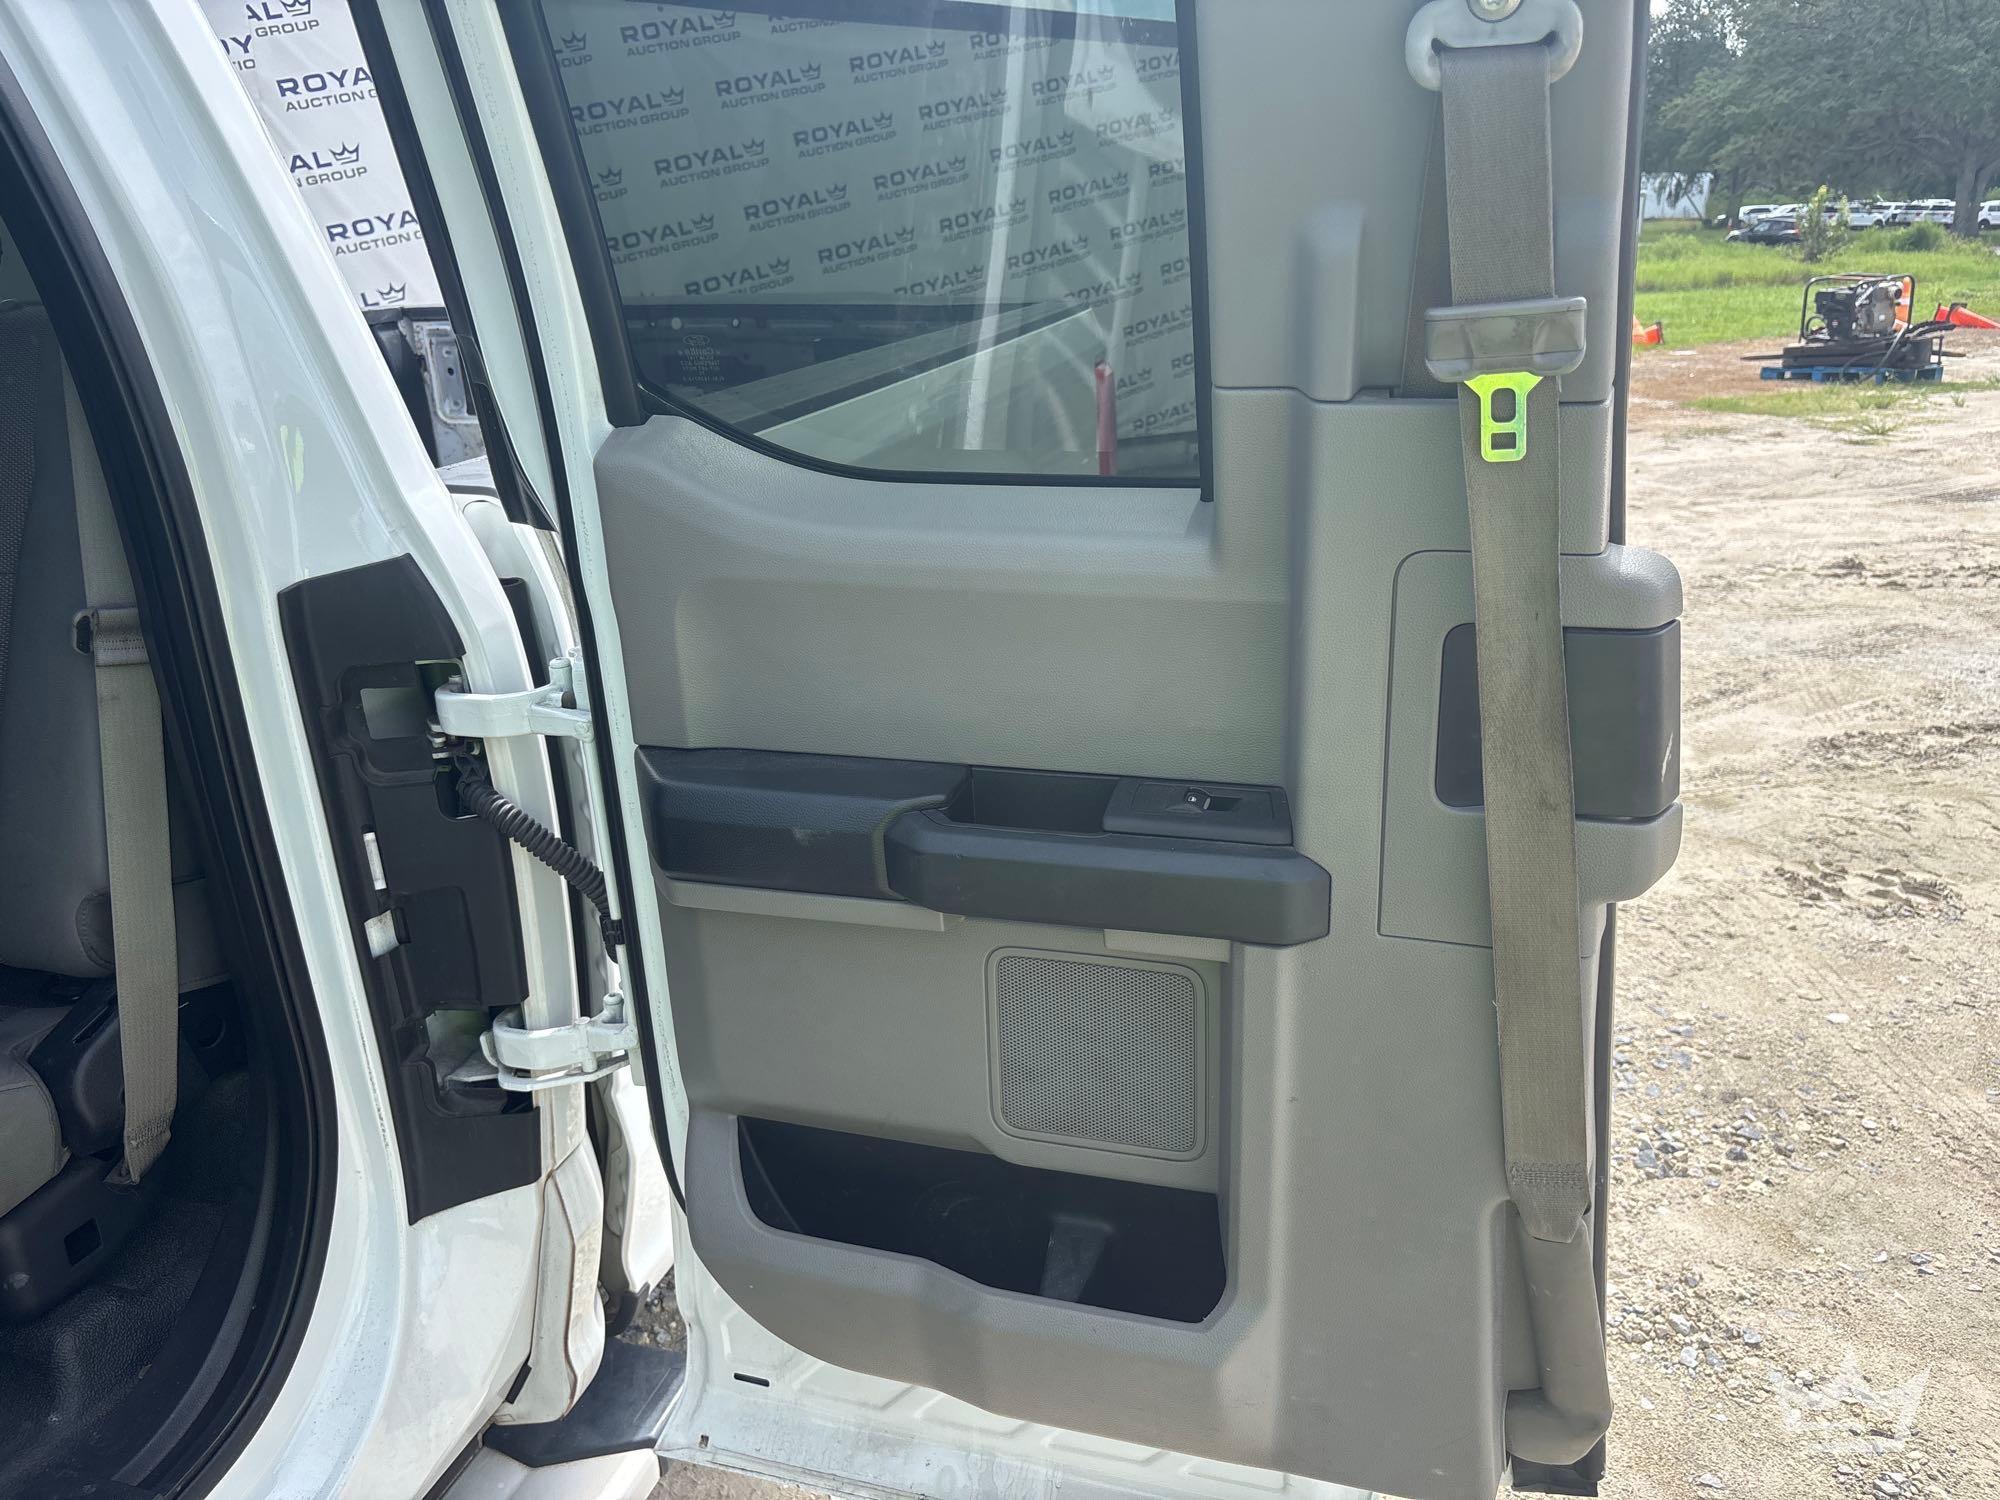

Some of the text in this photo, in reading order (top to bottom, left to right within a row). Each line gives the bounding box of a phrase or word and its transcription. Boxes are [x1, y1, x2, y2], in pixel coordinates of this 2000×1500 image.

[254, 20, 320, 37] GROUP
[619, 16, 714, 44] ROYAL
[626, 30, 741, 57] AUCTION GROUP
[849, 45, 927, 73] ROYAL
[852, 59, 949, 85] AUCTION GROUP
[715, 68, 801, 97] ROYAL
[720, 82, 826, 110] AUCTION GROUP
[1032, 69, 1098, 97] ROYAL
[286, 90, 365, 112] AUCTION
[569, 93, 662, 122] ROYAL
[918, 94, 990, 121] ROYAL
[640, 107, 690, 126] GROUP
[922, 114, 972, 133] AUCTION
[793, 118, 874, 147] ROYAL
[798, 130, 897, 159] AUCTION GROUP
[654, 144, 744, 176] ROYAL
[990, 136, 1057, 163] ROYAL
[305, 166, 368, 187] GROUP
[660, 157, 770, 189] AUCTION GROUP
[873, 161, 949, 191] ROYAL
[877, 173, 969, 203] AUCTION GROUP
[1048, 177, 1112, 204] ROYAL
[743, 190, 827, 221] ROYAL
[749, 201, 851, 232] AUCTION GROUP
[939, 203, 1009, 233] ROYAL
[606, 221, 693, 251] ROYAL
[1110, 214, 1169, 241] ROYAL
[335, 233, 412, 257] AUCTION
[671, 232, 719, 252] GROUP
[817, 233, 896, 264] ROYAL
[1008, 241, 1072, 270] ROYAL
[822, 254, 875, 275] AUCTION
[684, 265, 771, 296] ROYAL
[749, 275, 794, 295] GROUP
[1123, 311, 1180, 339] ROYAL
